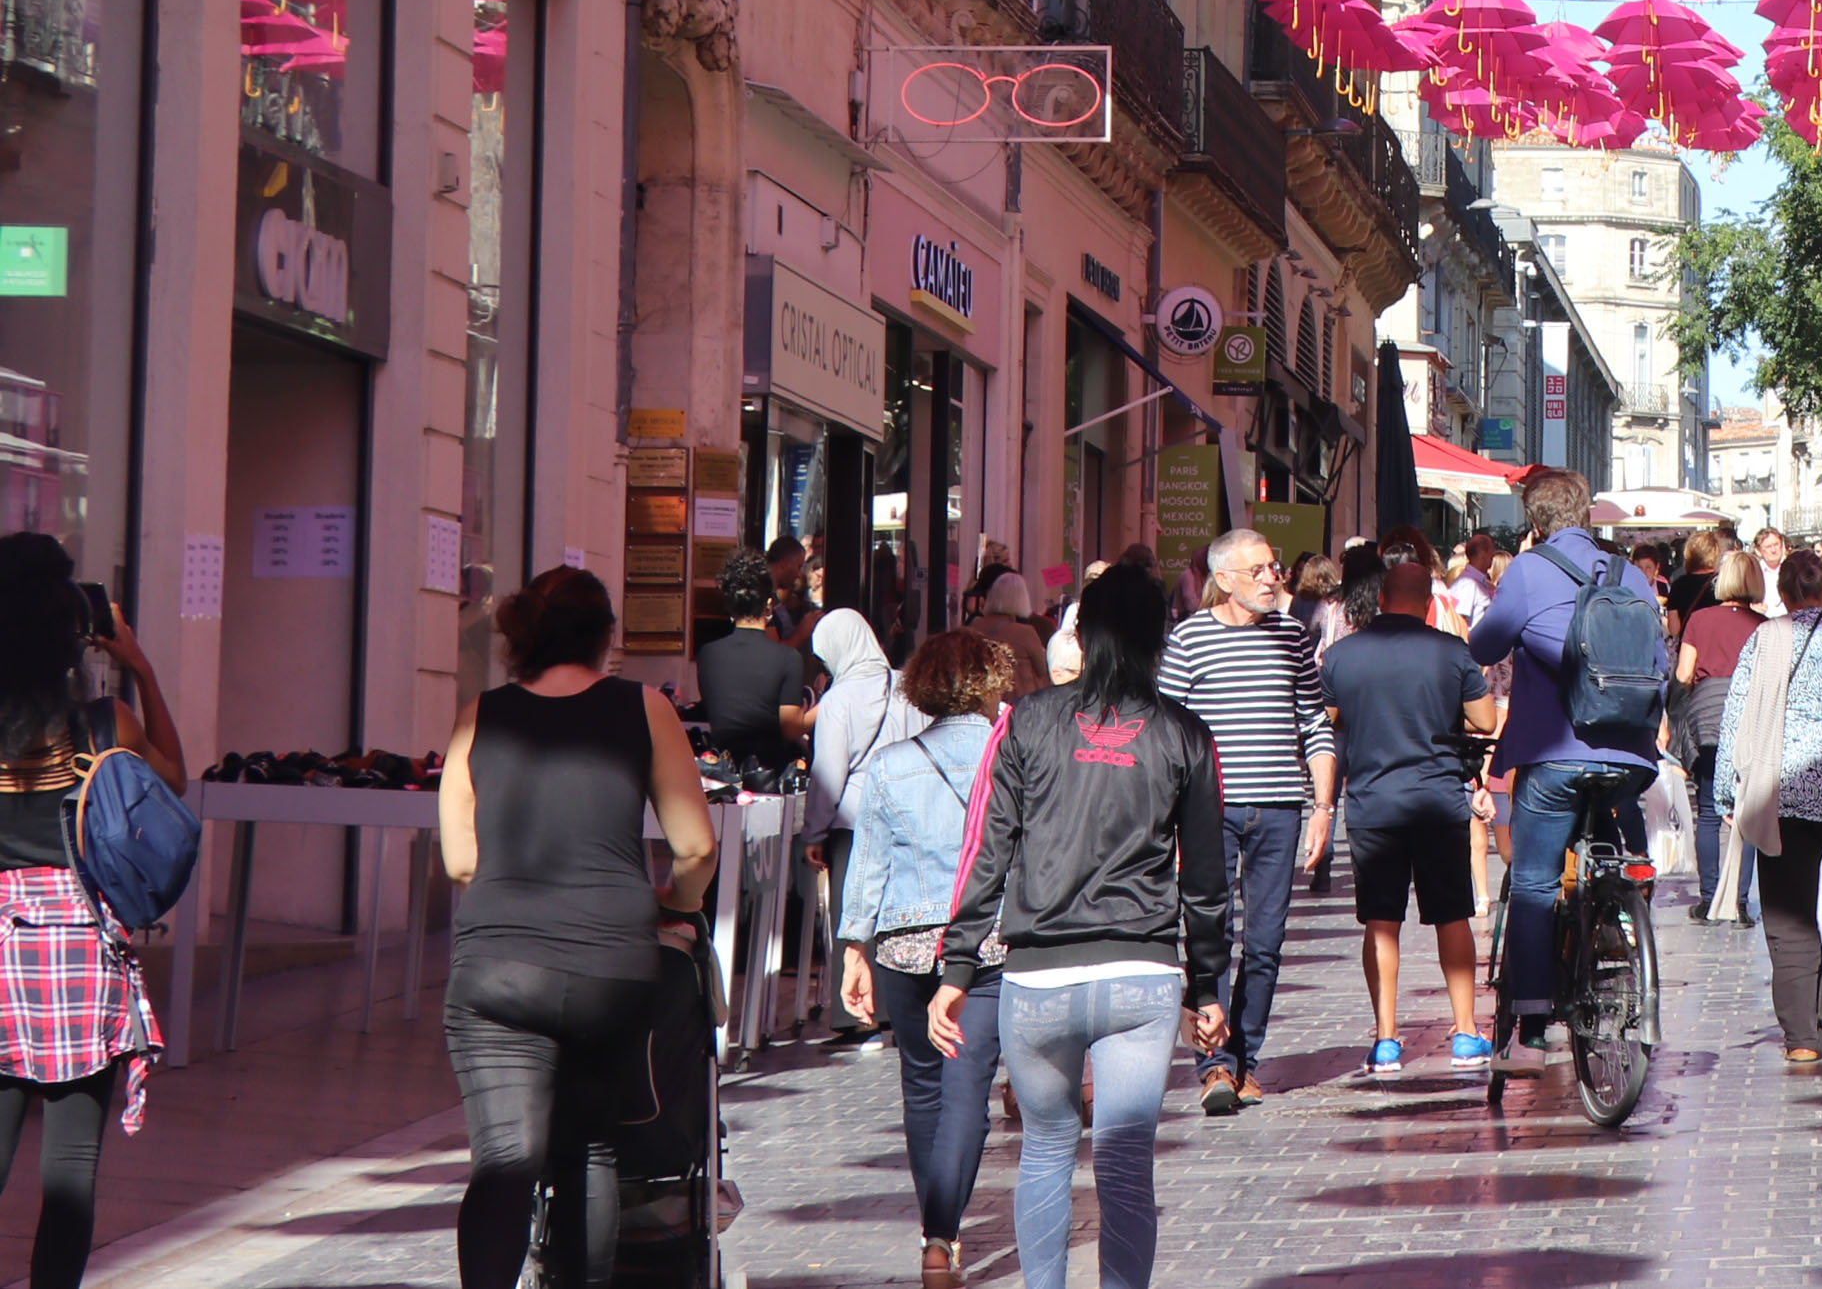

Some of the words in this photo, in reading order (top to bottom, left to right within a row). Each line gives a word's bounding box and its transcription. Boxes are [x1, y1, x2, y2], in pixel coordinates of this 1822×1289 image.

[1163, 325, 1184, 349] PETIT
[1187, 327, 1218, 351] BATEAU
[780, 301, 827, 371] CRISTAL
[831, 328, 877, 396] OPTICAL
[1169, 465, 1199, 477] PARIS
[1158, 481, 1209, 492] BANGKOK
[1159, 496, 1208, 507] MOSCOU
[1162, 511, 1204, 522] MEXICO
[1267, 514, 1291, 525] 1959
[1073, 746, 1137, 768] adidas
